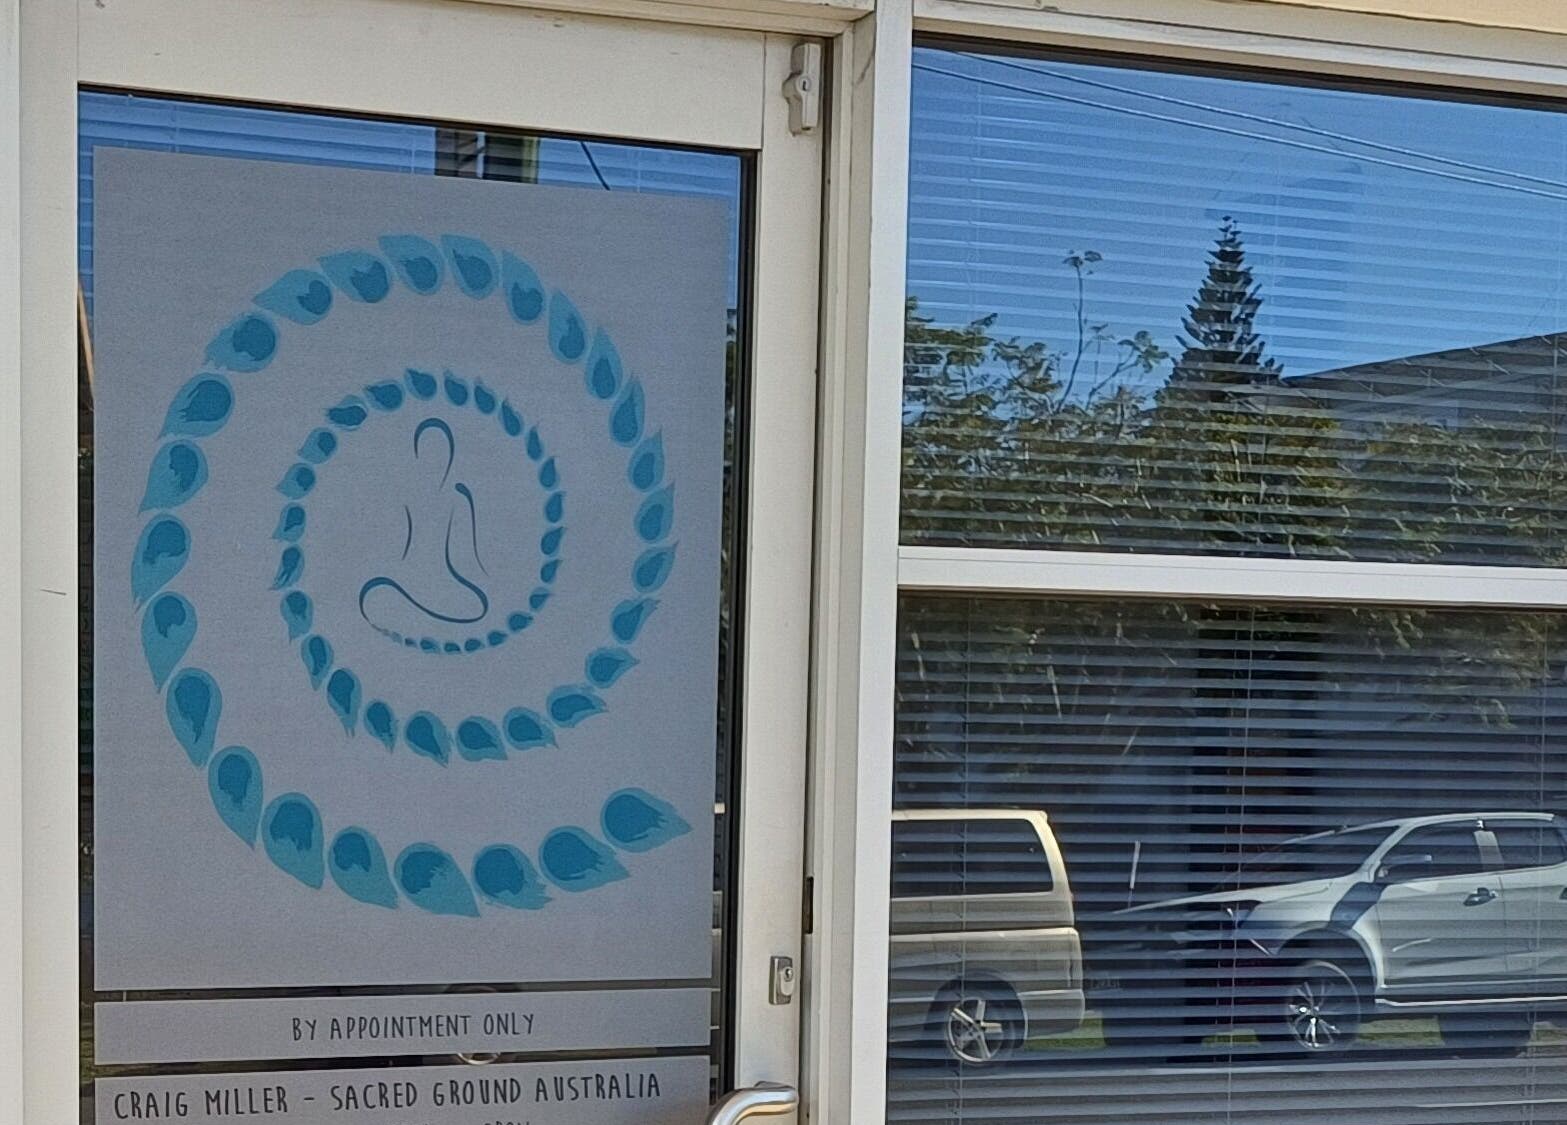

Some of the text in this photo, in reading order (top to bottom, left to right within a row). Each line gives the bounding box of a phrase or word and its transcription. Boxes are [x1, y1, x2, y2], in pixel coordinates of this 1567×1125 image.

[293, 1011, 535, 1041] BY APPOINTMENT ONLY
[114, 1090, 188, 1120] CRAIG
[205, 1085, 288, 1116] MILLER
[330, 1081, 418, 1111] SACRED
[433, 1077, 522, 1107] GROUND
[535, 1072, 661, 1103] AUSTRALIA
